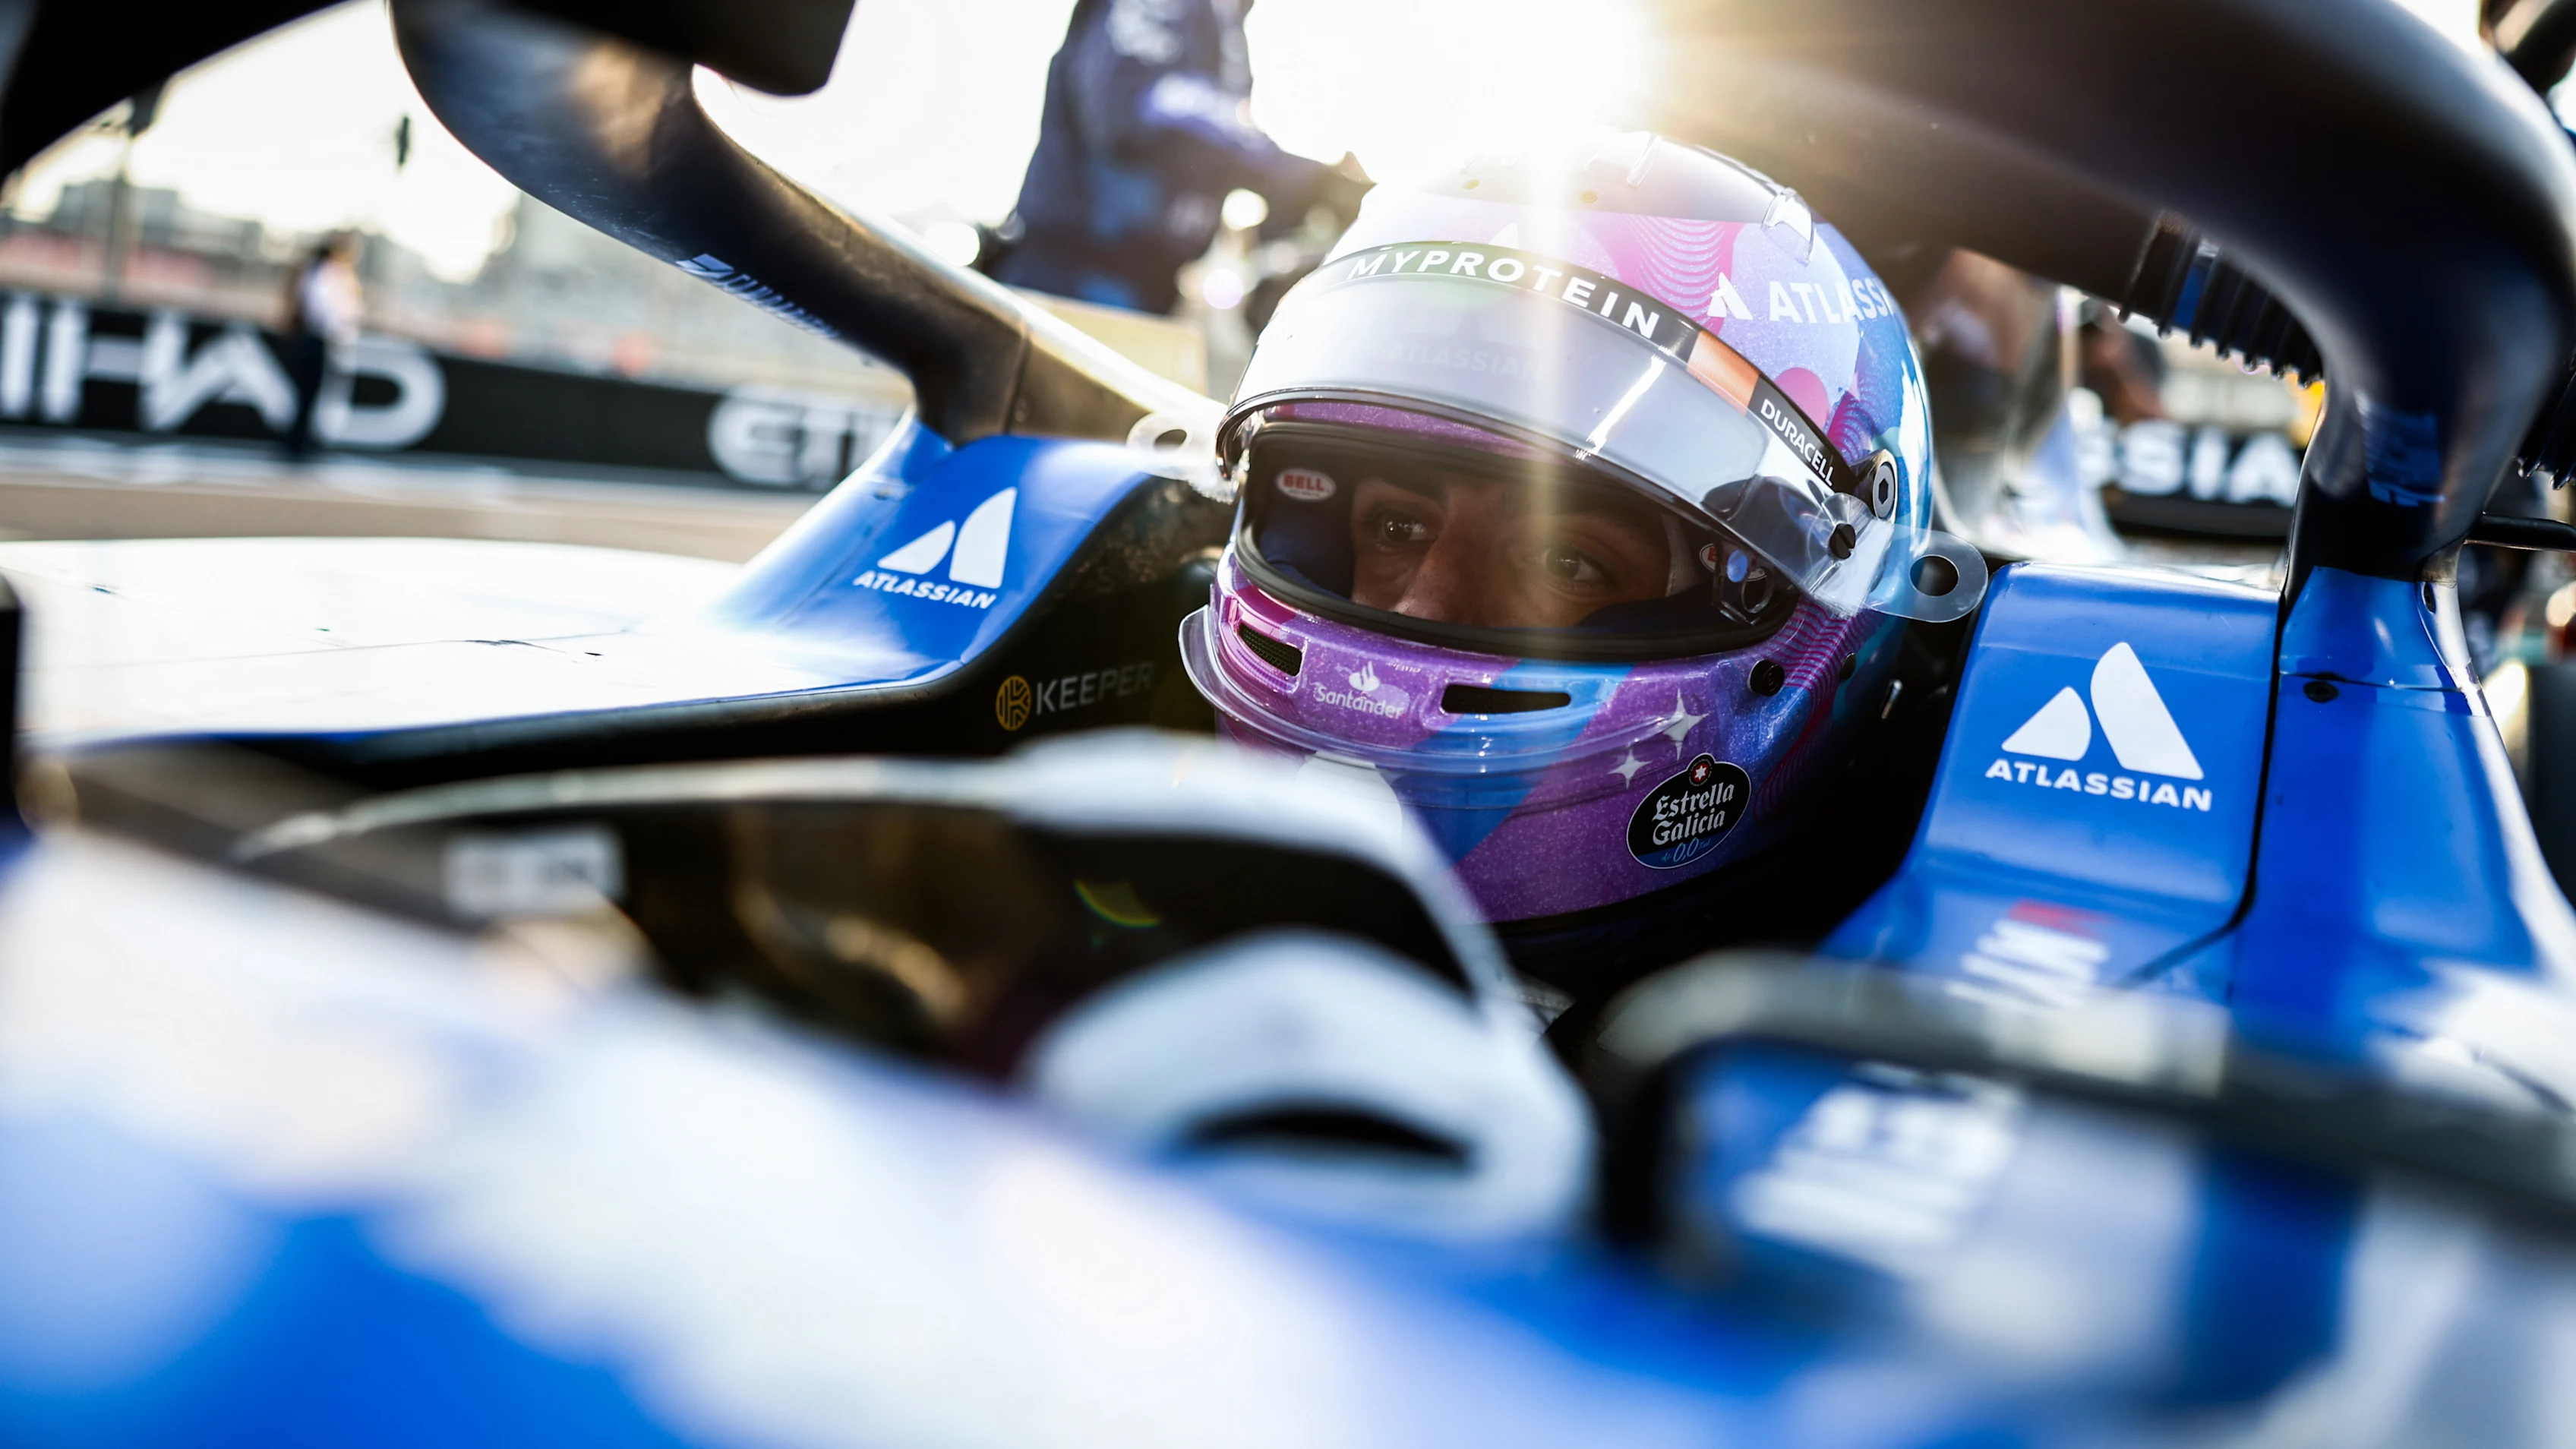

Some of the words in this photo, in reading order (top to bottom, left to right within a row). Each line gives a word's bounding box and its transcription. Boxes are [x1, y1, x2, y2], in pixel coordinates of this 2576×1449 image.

[1346, 251, 1660, 339] MYPROTEIN
[1760, 399, 1834, 487] DURACELL
[1283, 473, 1326, 493] BELL
[852, 570, 997, 609] ATLASSIAN
[1036, 661, 1155, 715] KEEPER
[1314, 685, 1405, 719] Santander
[1652, 781, 1735, 822] Estrella
[1984, 758, 2213, 812] ATLASSIAN
[1653, 807, 1726, 846] Galicia
